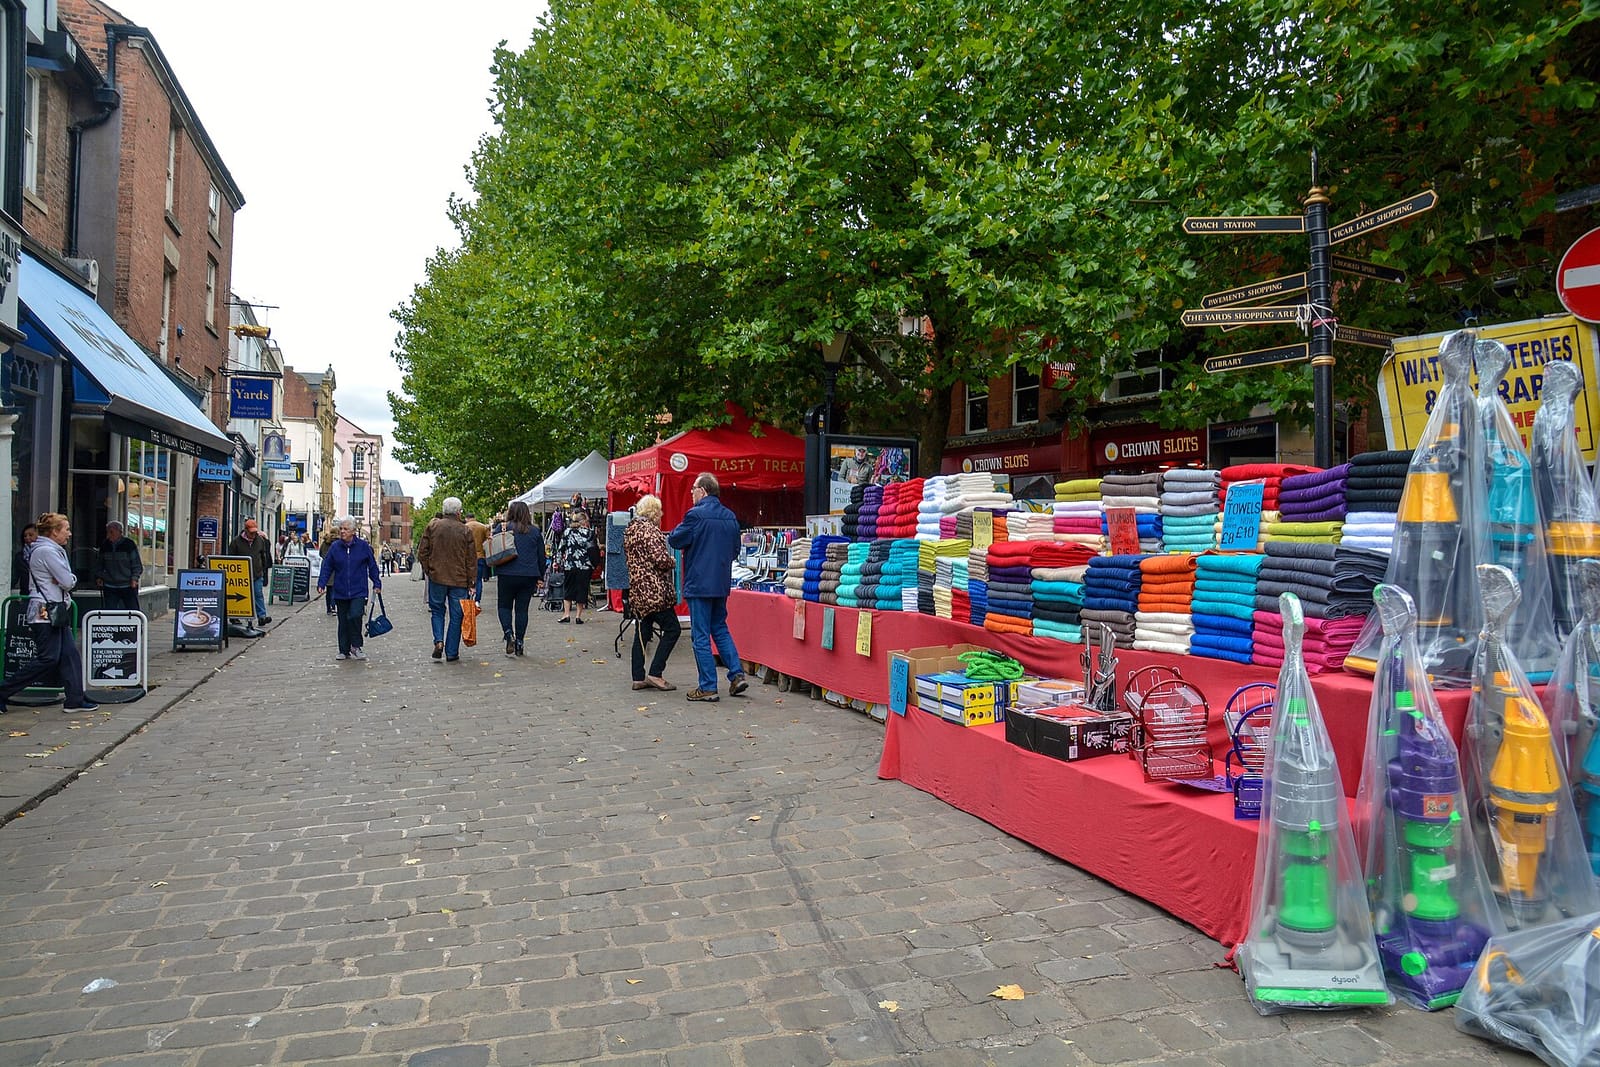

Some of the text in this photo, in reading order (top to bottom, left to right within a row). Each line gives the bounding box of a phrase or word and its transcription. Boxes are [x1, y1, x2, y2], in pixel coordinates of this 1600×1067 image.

[1190, 221, 1257, 229] COACH STATION
[1333, 203, 1413, 239] VICAR LANE SHOPPING
[1208, 282, 1283, 306] PAVEMENTS SHOPPING
[1185, 314, 1203, 322] THE
[1205, 313, 1232, 321] YARDS
[1234, 311, 1274, 320] SHOPPING
[1210, 357, 1242, 369] LIBRARY
[234, 389, 269, 401] Yards
[150, 429, 160, 443] THE
[1226, 425, 1259, 438] Telephone
[1121, 436, 1199, 458] CROWN SLOTS
[712, 458, 755, 471] TASTY
[974, 454, 1029, 471] CROWN SLOTS
[200, 467, 231, 476] NERO
[1227, 489, 1234, 501] 2
[1227, 501, 1261, 515] TOWELS
[1109, 513, 1135, 524] JUMBO
[1235, 526, 1255, 539] £10
[217, 563, 242, 573] SHOE
[1331, 975, 1358, 984] dyson
